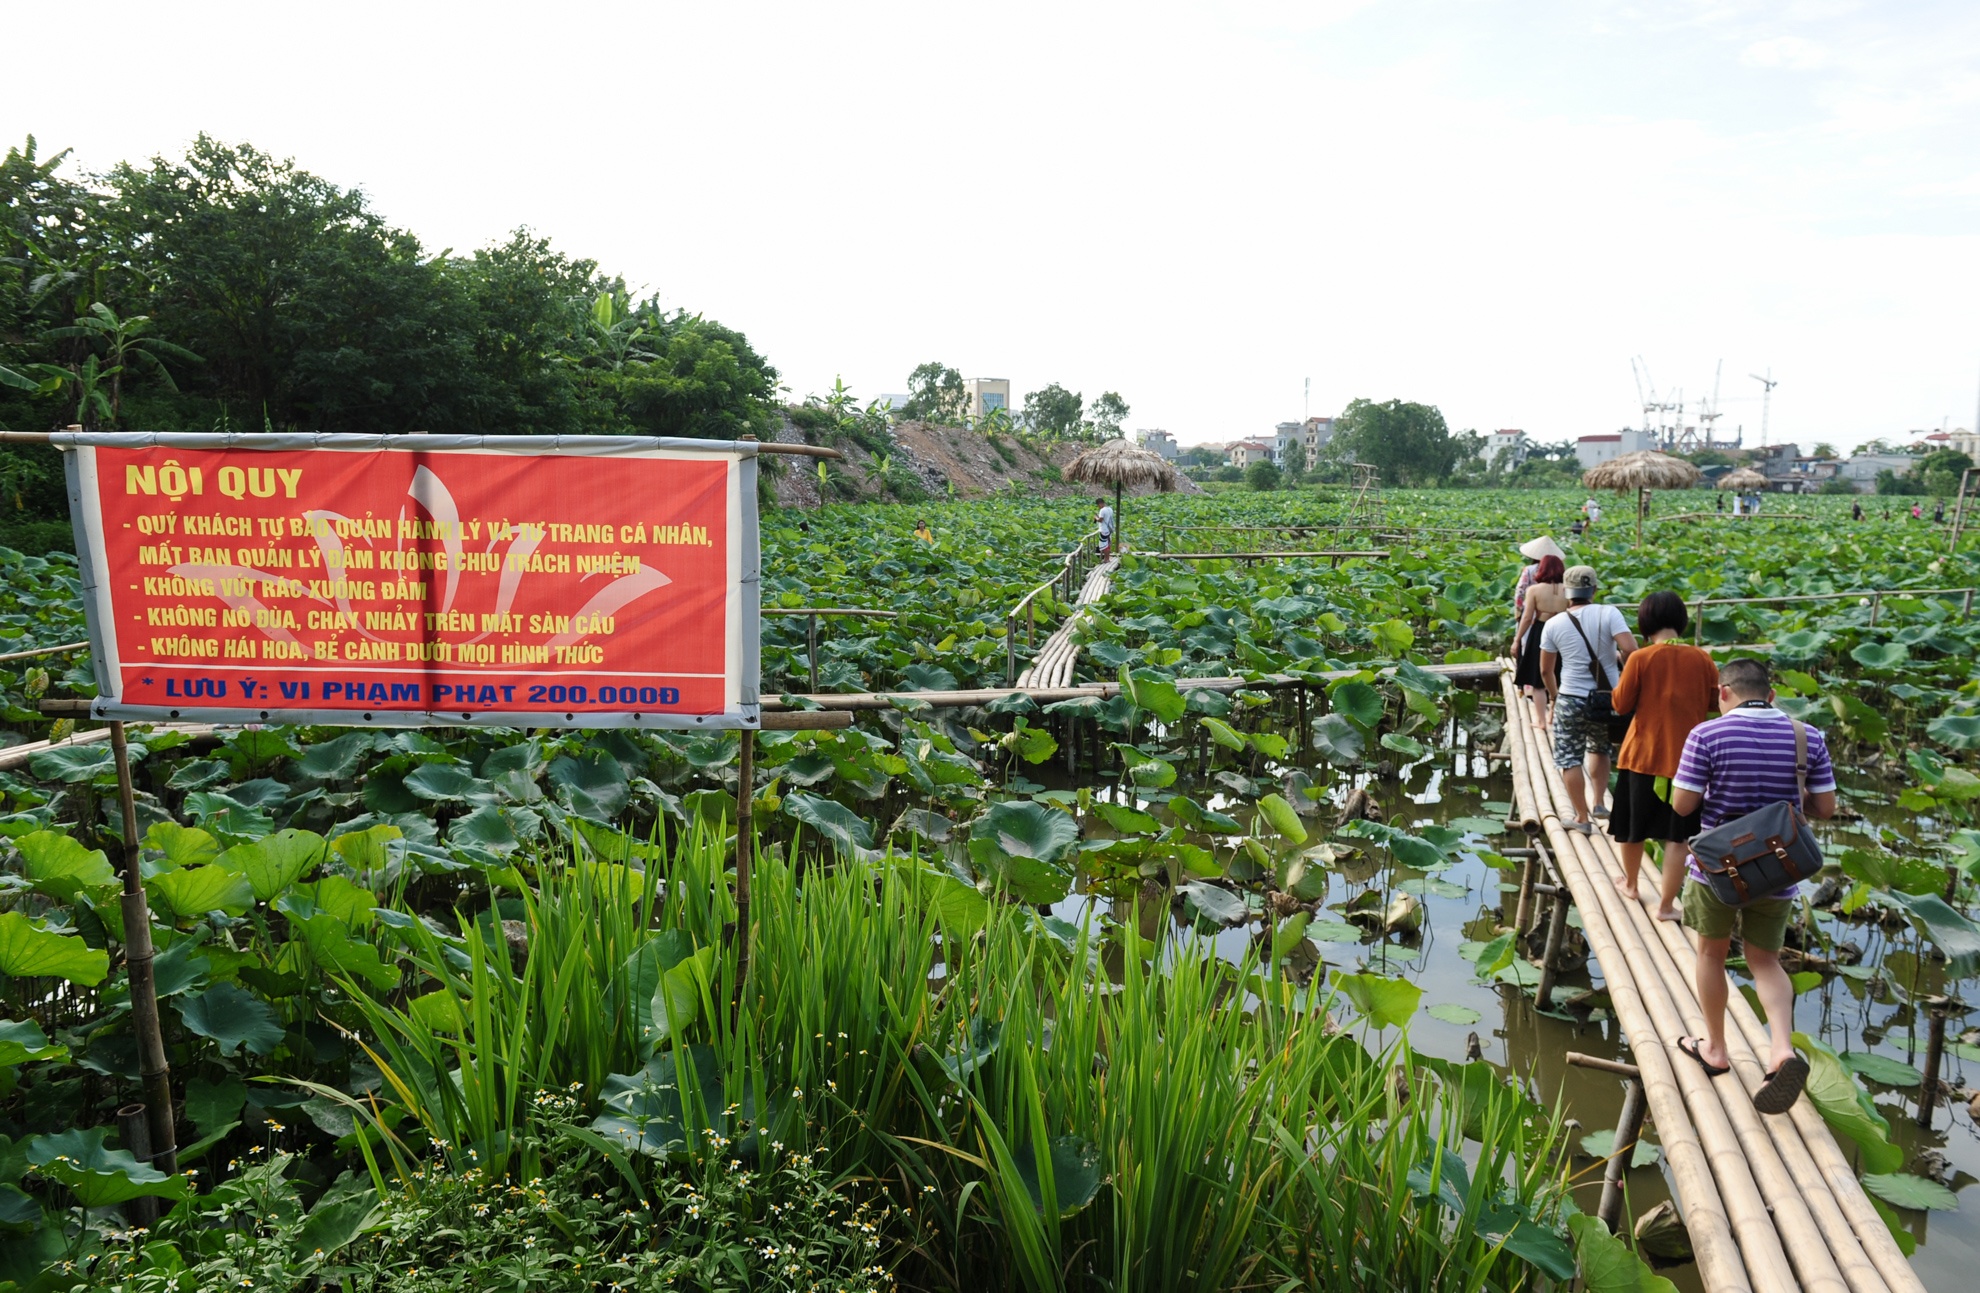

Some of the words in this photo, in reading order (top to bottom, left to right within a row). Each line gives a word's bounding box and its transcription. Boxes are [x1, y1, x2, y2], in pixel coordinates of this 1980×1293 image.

[125, 459, 203, 502] NỘI
[218, 467, 303, 500] QUY
[137, 511, 178, 535] QUÝ
[183, 513, 252, 536] KHÁCH
[257, 517, 285, 541] TỰ
[290, 510, 329, 538] BẢO
[336, 511, 392, 539] QUẢN
[398, 516, 451, 540] HÀNH
[458, 517, 482, 541] LÝ
[487, 518, 513, 542] VÀ
[518, 520, 546, 542] TƯ
[549, 523, 615, 544] TRANG
[620, 522, 647, 544] CÁ
[653, 522, 713, 548] NHÂN,
[138, 539, 183, 566] MẤT
[189, 547, 233, 567] BAN
[238, 540, 293, 569] QUẢN
[298, 544, 322, 569] LÝ
[327, 543, 374, 570] ĐẦM
[379, 546, 448, 571] KHÔNG
[454, 552, 500, 577] CHỊU
[506, 551, 570, 573] TRÁCH
[576, 551, 641, 578] NHIỆM
[143, 573, 215, 597] KHÔNG
[220, 573, 257, 597] VỨT
[261, 575, 303, 598] RÁC
[308, 574, 376, 599] XUỐNG
[381, 574, 427, 601] ĐẦM
[147, 604, 217, 627] KHÔNG
[222, 607, 251, 628] NÔ
[256, 606, 302, 632] ĐÙA,
[307, 610, 359, 634] CHẠY
[365, 603, 418, 631] NHẢY
[424, 609, 475, 632] TRÊN
[481, 611, 524, 637] MẶT
[529, 610, 570, 634] SÀN
[575, 609, 615, 635] CẦU
[150, 634, 219, 658] KHÔNG
[224, 635, 256, 659] HÁI
[262, 640, 309, 662] HOA,
[314, 633, 339, 660] BẺ
[344, 636, 399, 660] CÀNH
[406, 638, 452, 662] DƯỚI
[458, 643, 495, 667] MỌI
[501, 640, 549, 664] HÌNH
[554, 640, 604, 665] THỨC
[166, 677, 227, 699] LƯU
[239, 677, 268, 699] Ý:
[278, 681, 310, 700] VI
[322, 682, 420, 705] PHẠM
[431, 684, 516, 707] PHẠT
[528, 685, 680, 705] 200.000Đ
